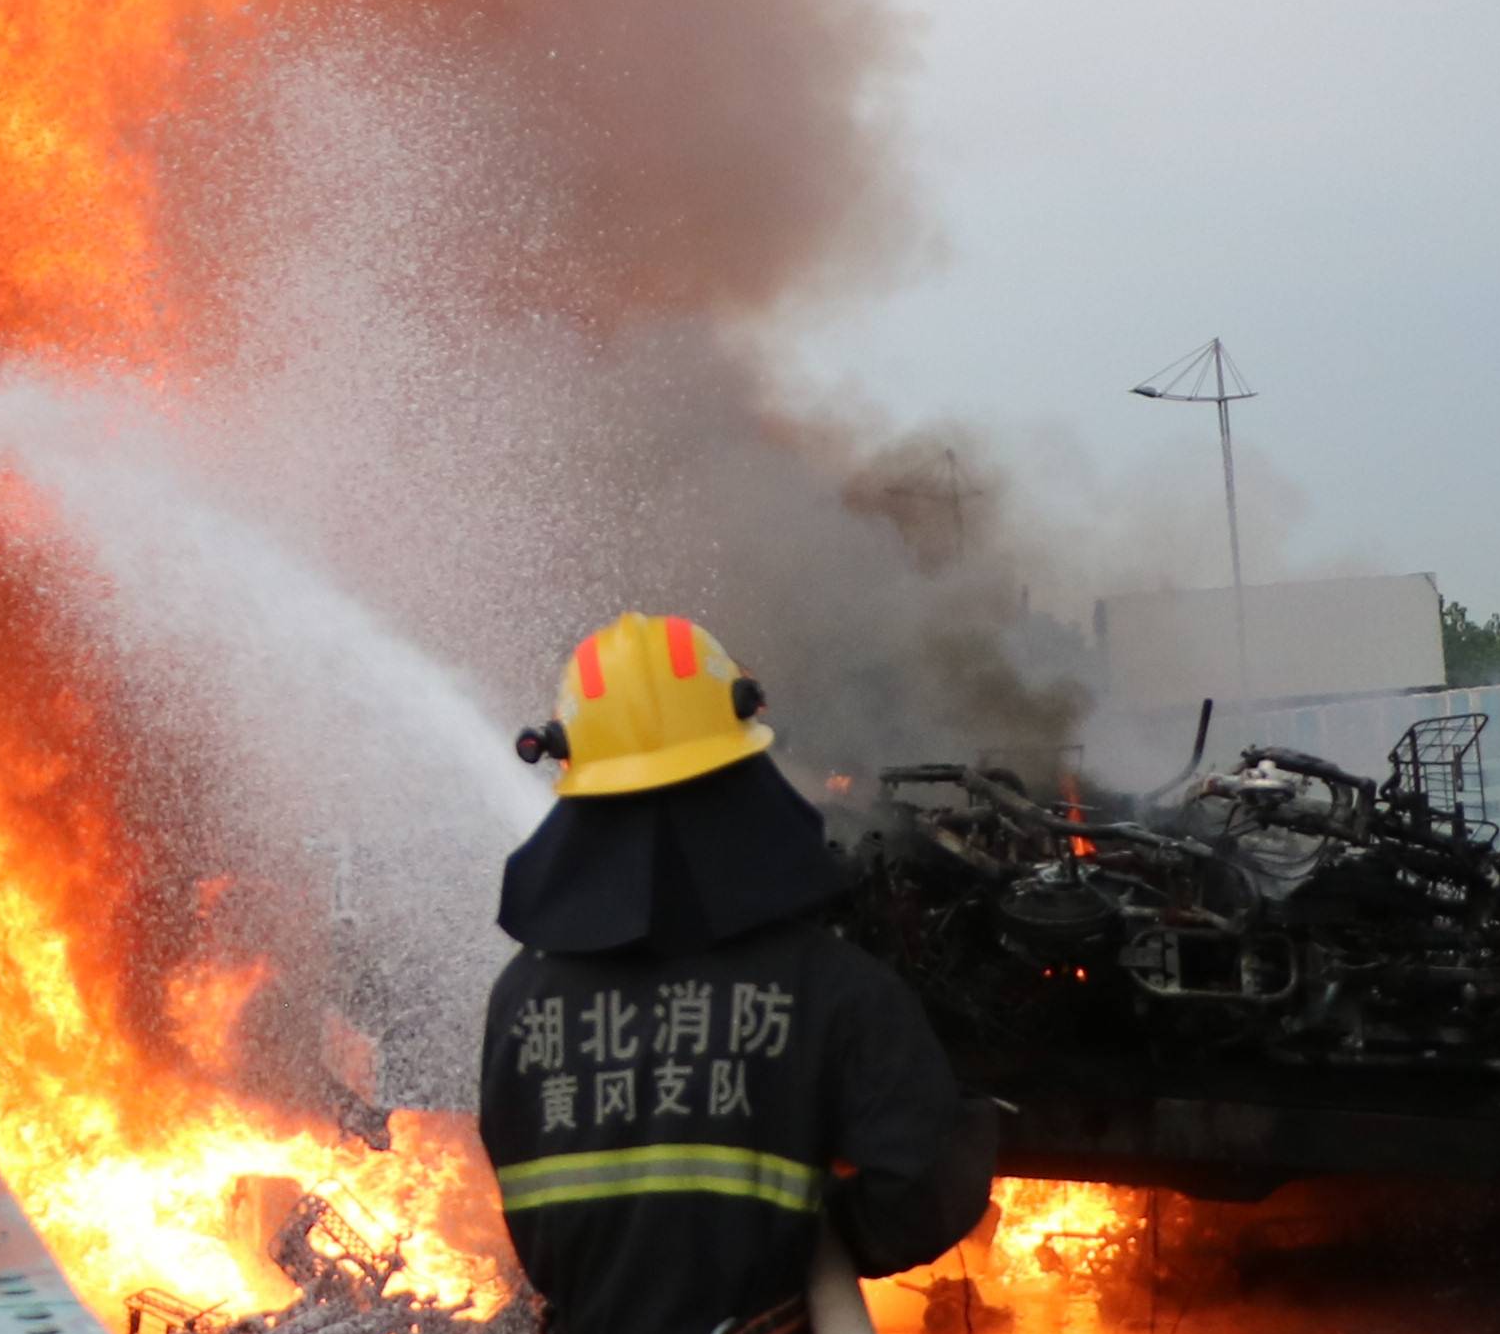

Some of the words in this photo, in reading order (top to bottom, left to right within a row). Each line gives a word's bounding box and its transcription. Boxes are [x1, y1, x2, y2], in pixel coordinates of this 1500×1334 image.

[511, 980, 793, 1074] 湖北消防
[541, 1059, 751, 1132] 黄冈支队
